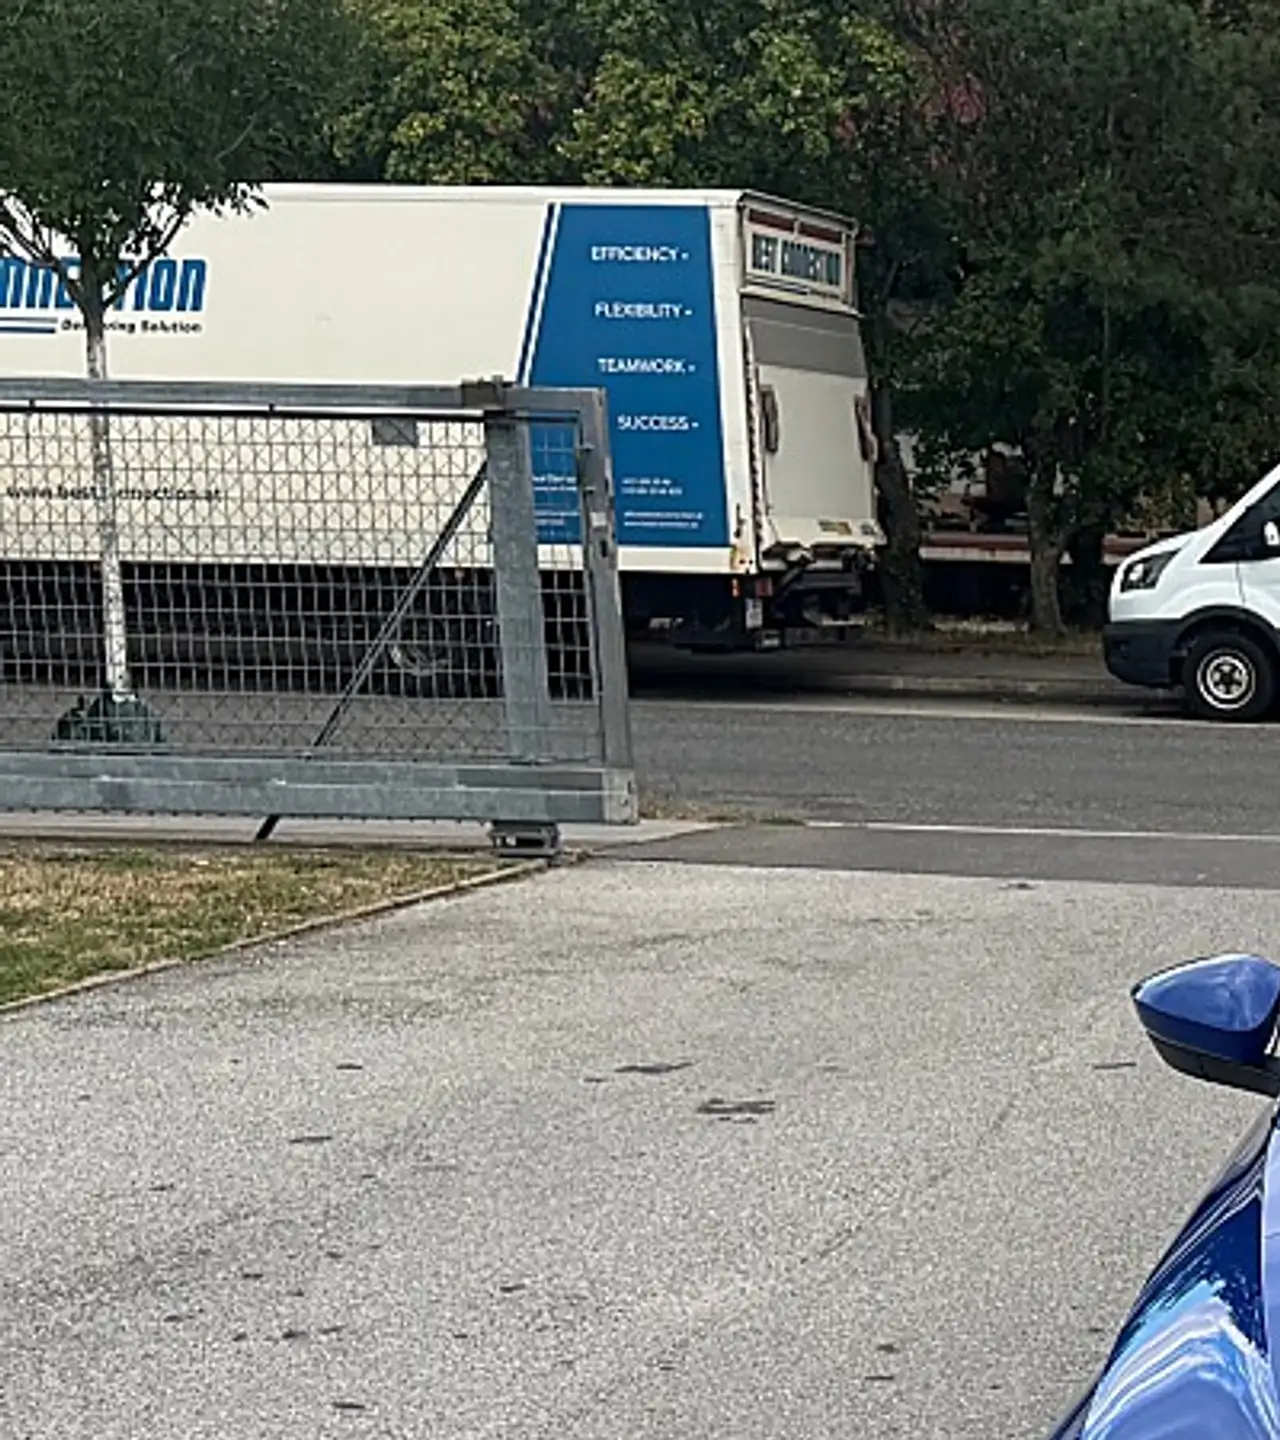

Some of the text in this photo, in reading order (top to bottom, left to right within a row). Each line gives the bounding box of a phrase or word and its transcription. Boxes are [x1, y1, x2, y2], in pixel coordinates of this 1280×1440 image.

[591, 246, 679, 261] EFFICIENCY
[595, 302, 683, 318] FLEXIBILITY
[597, 358, 686, 374] TEAMWORK
[617, 415, 690, 430] SUCCESS
